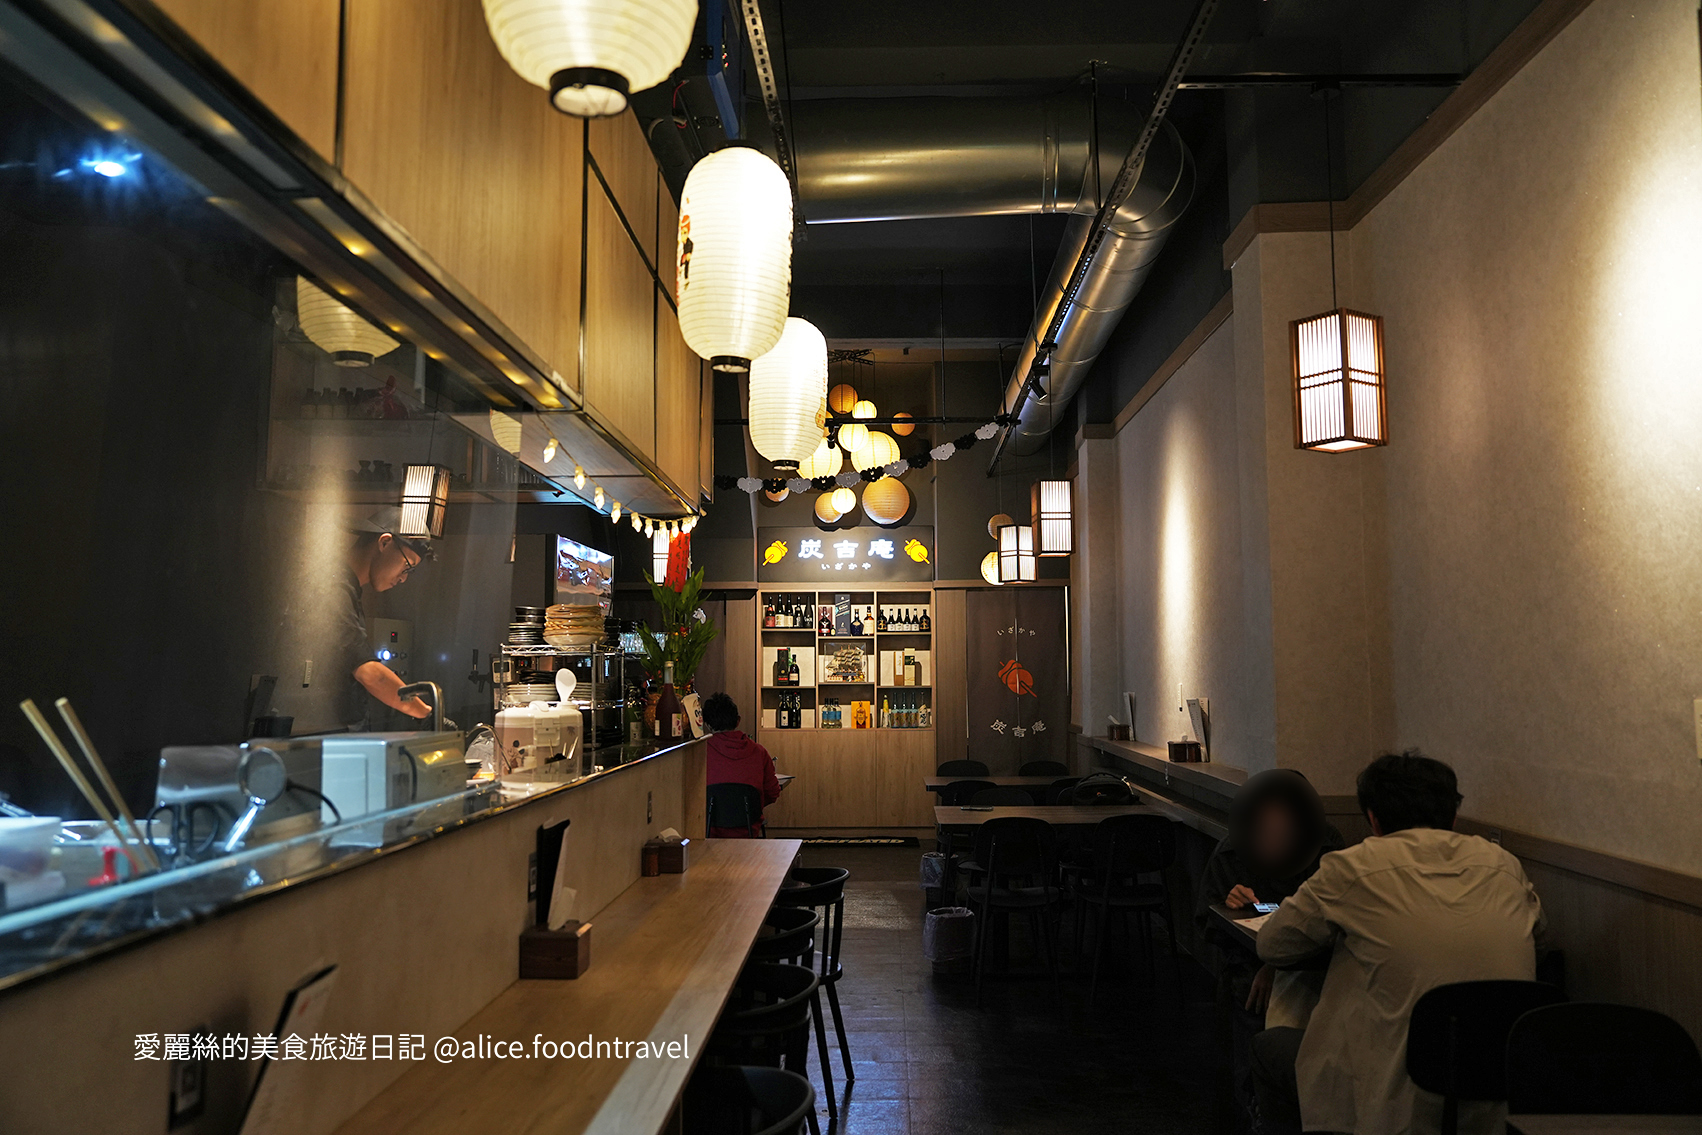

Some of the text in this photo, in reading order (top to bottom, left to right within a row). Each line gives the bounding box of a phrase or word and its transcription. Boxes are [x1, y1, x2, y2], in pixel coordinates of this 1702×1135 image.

[798, 538, 894, 559] 炭吉庵
[821, 562, 871, 571] いざかや
[996, 626, 1036, 636] いざかや
[990, 719, 1047, 738] 炭吉庵
